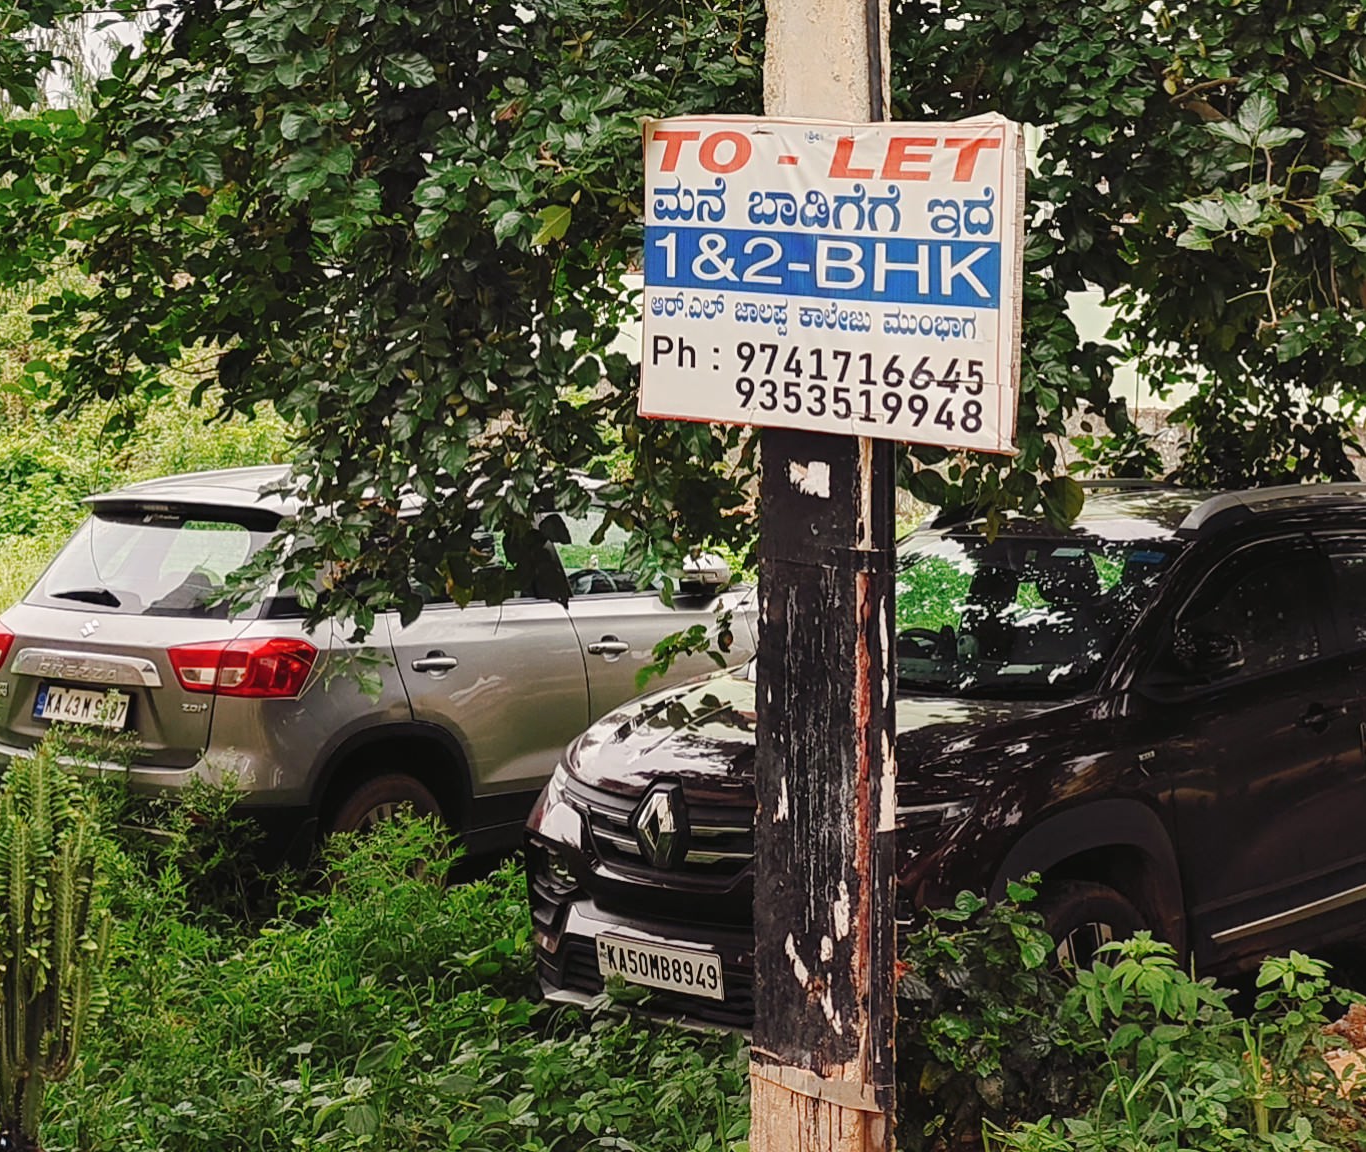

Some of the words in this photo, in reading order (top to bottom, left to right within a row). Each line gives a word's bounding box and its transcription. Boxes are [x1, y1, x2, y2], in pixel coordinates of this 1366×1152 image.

[652, 131, 753, 175] TO
[828, 136, 1002, 182] LET
[653, 176, 727, 223] ಮನೆ
[748, 183, 902, 233] ಬಾಡಿಗೆಗೆ
[927, 186, 995, 239] ಇದೆ
[654, 231, 992, 299] 1&2-BHK
[799, 302, 872, 333] ಕಾಲೇಜು
[883, 306, 977, 341] ಮುಂಭಾಗ
[652, 335, 696, 368] Ph
[736, 341, 984, 396] 9741716645
[735, 377, 982, 433] 9353519948
[45, 692, 63, 714] KA
[64, 695, 81, 716] 43
[607, 944, 718, 991] KA50MB8949
